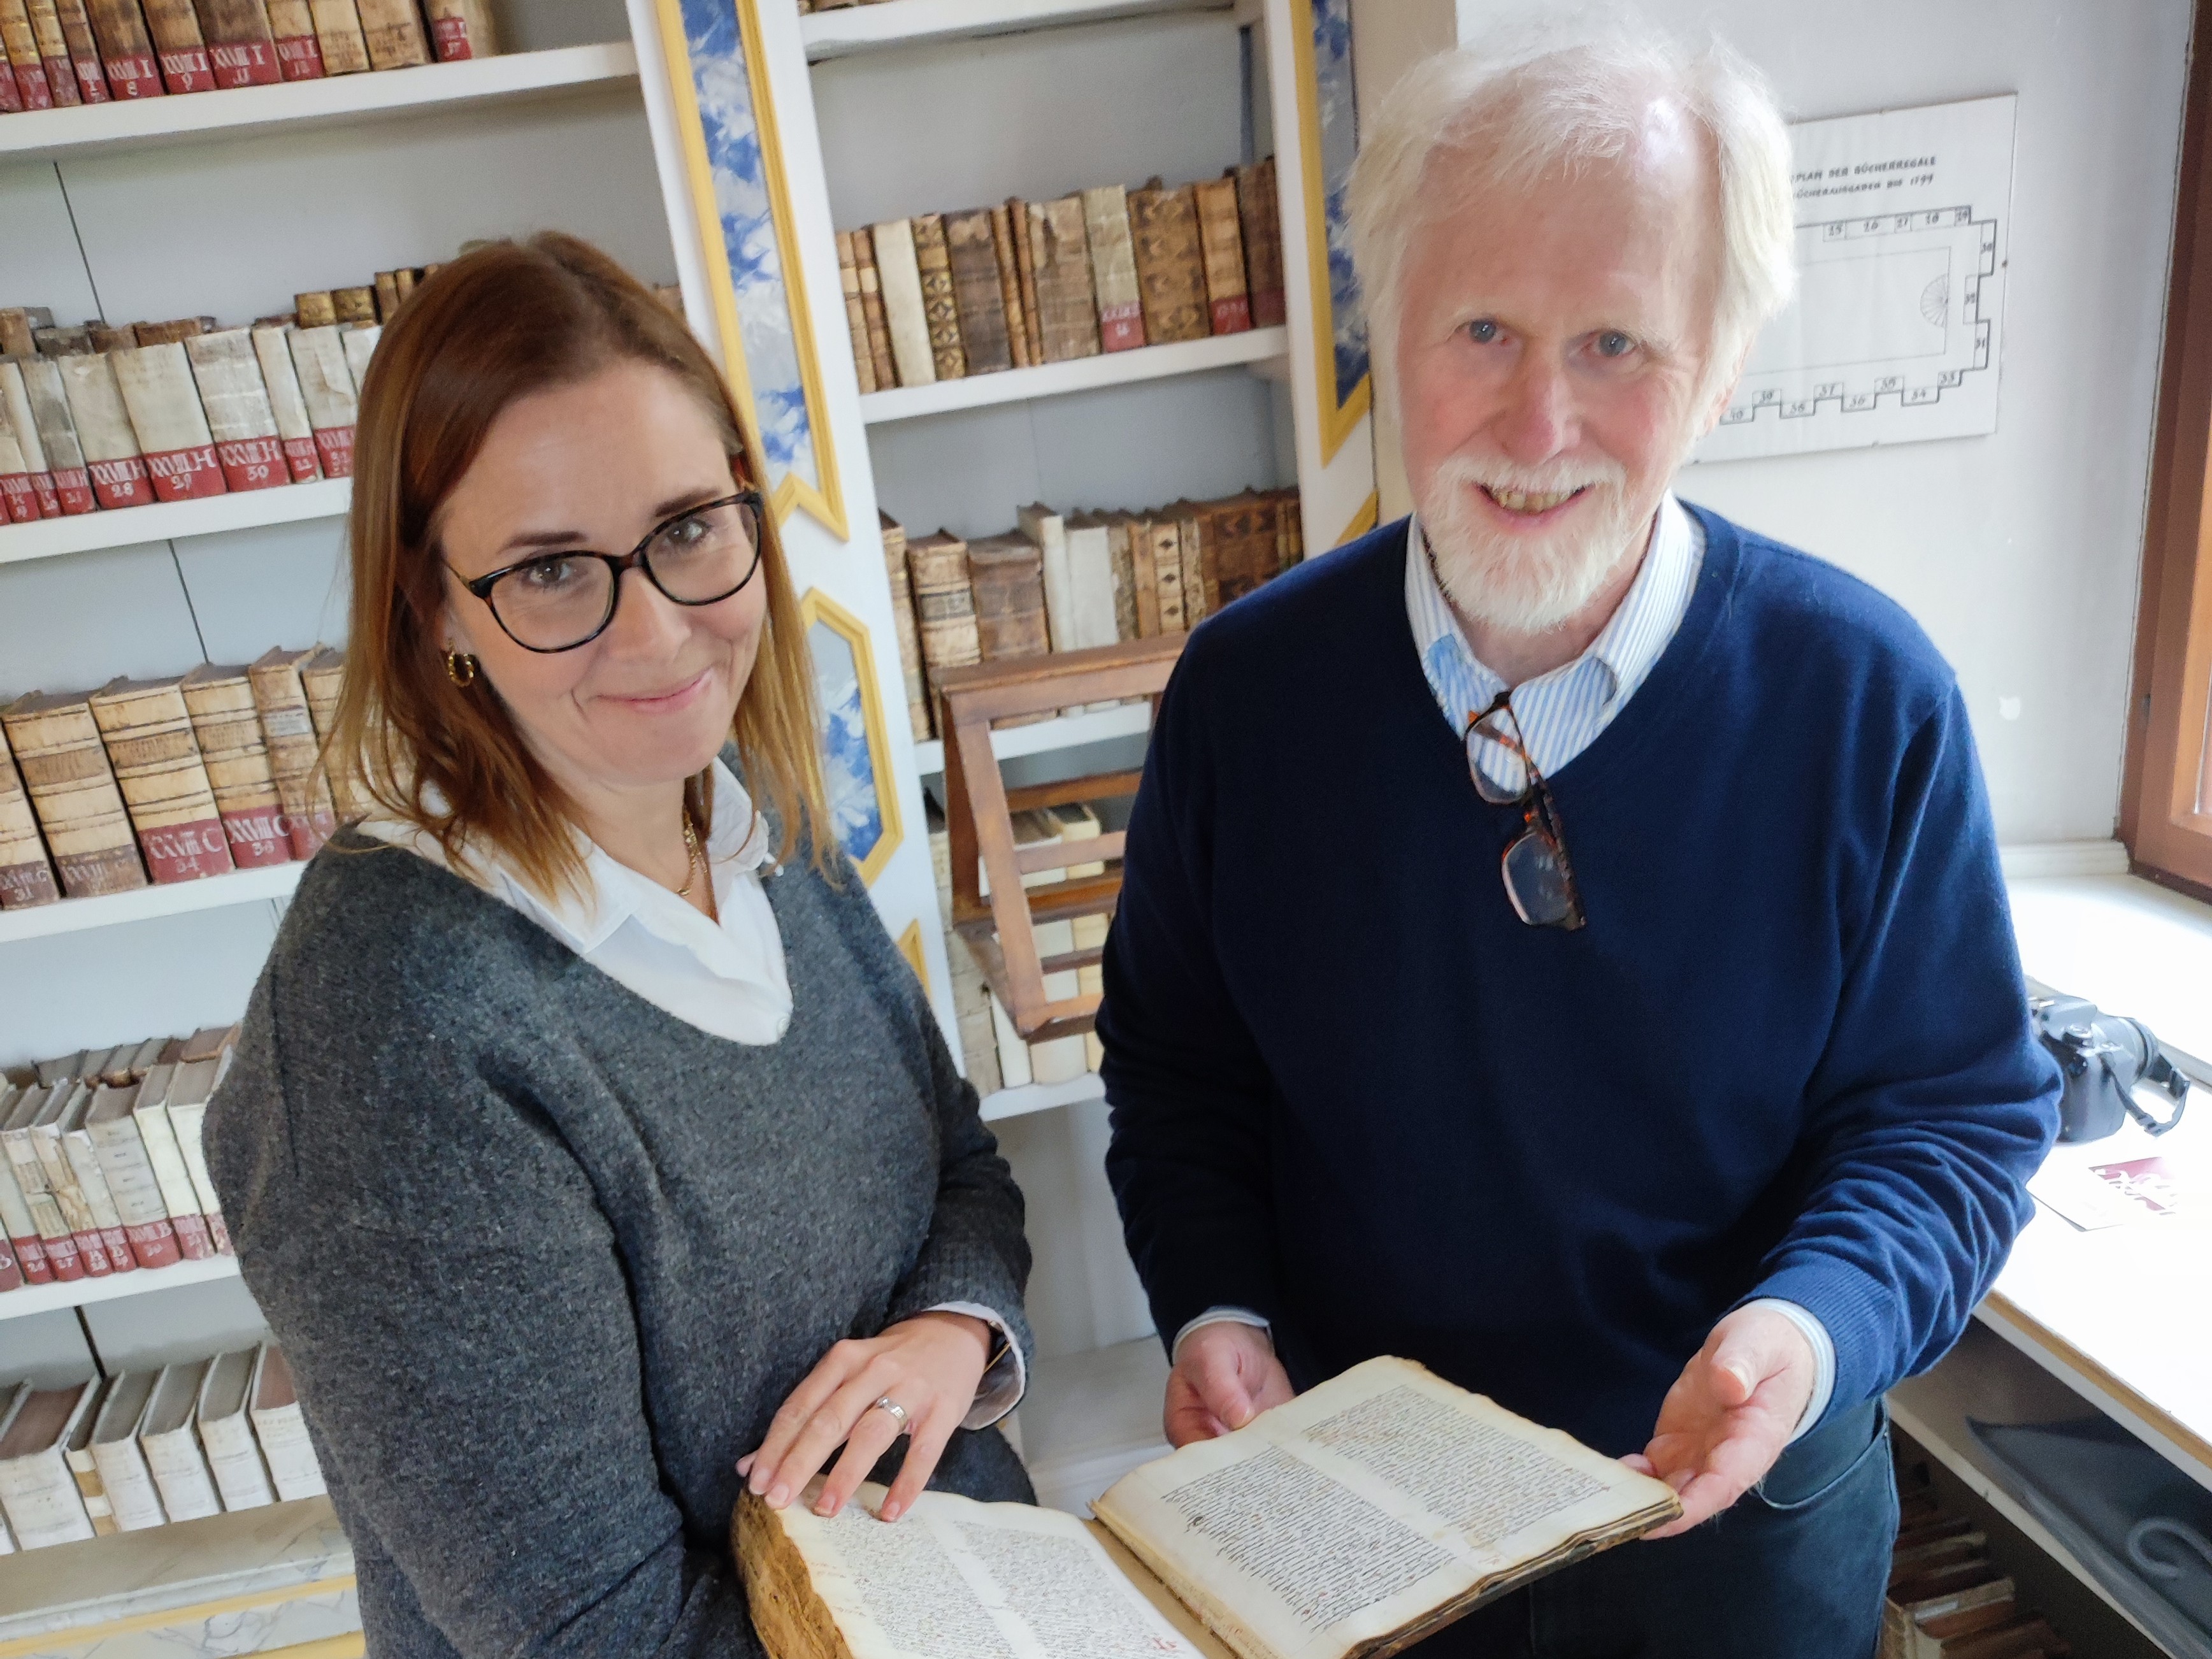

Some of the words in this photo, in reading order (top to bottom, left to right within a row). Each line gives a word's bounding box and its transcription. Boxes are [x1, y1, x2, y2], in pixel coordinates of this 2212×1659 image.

[1791, 170, 1823, 183] PLAN
[1828, 167, 1848, 178] DER
[1854, 156, 1937, 175] BÜCHERREGALE
